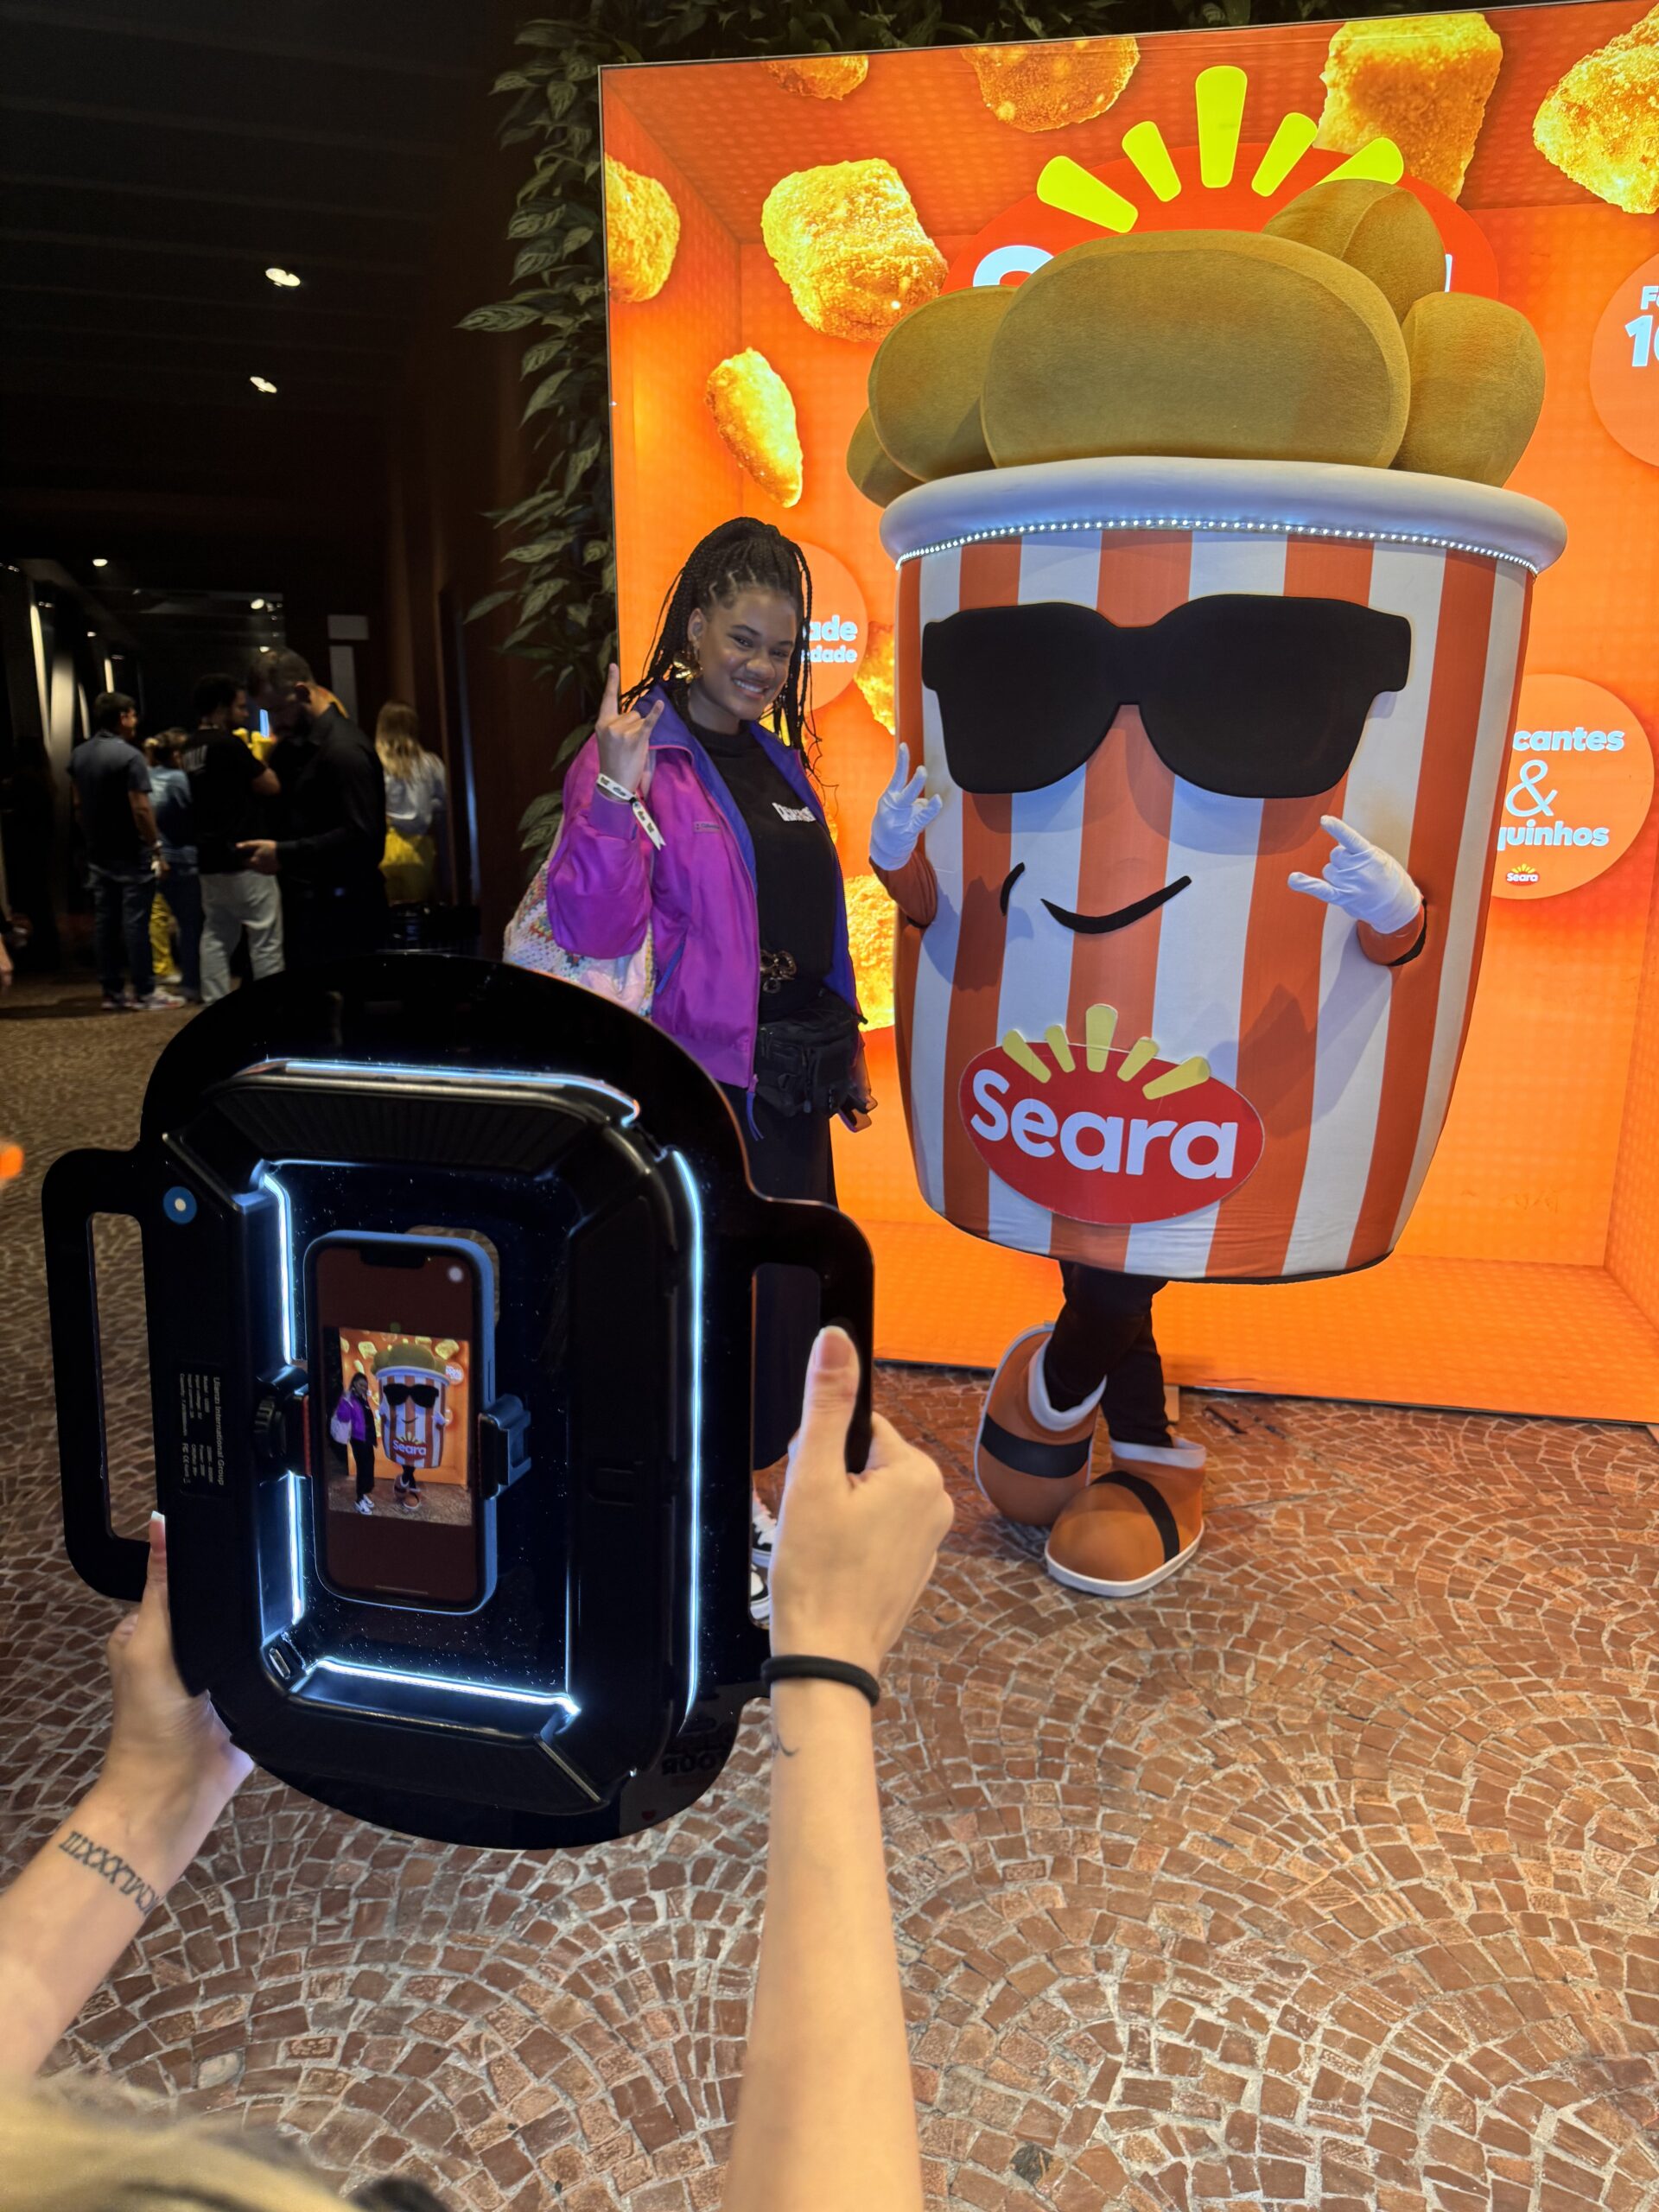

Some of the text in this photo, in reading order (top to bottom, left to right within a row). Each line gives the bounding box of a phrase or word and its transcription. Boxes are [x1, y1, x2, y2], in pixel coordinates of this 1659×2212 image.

[1512, 727, 1624, 751] cantes
[1505, 760, 1558, 817] &
[1506, 873, 1538, 882] Seara
[970, 1069, 1238, 1179] Seara
[392, 1439, 427, 1456] Seara
